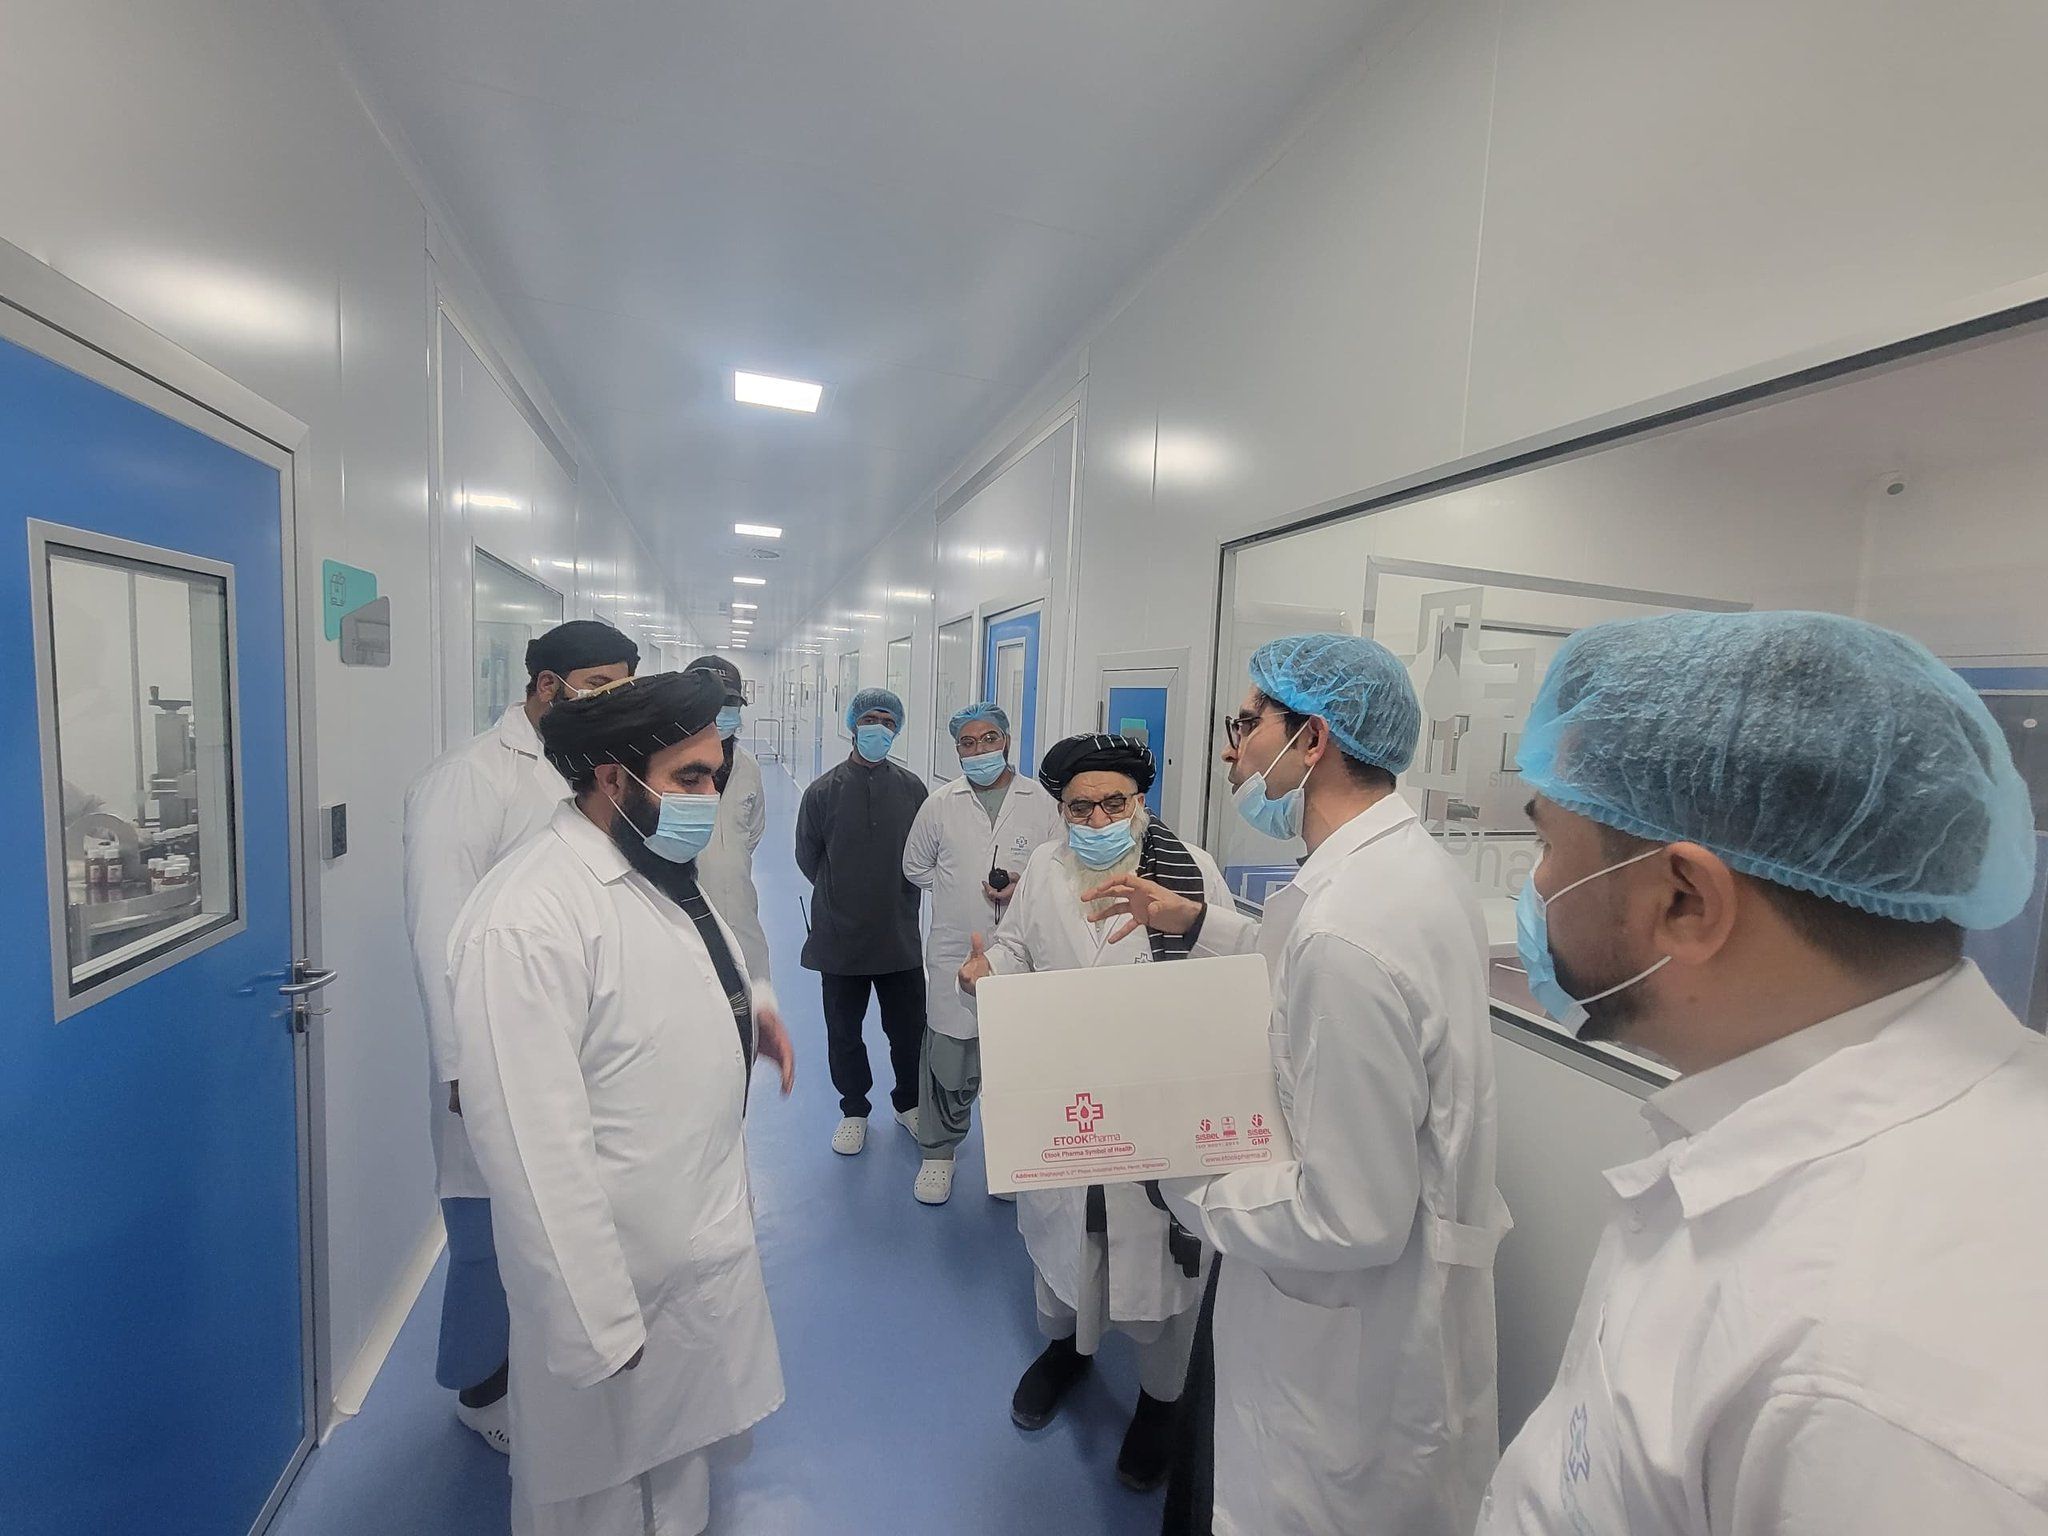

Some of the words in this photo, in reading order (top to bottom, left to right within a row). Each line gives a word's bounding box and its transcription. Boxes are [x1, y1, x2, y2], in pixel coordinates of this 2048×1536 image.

[1053, 1133, 1121, 1146] ETOOKPharma
[1251, 1138, 1270, 1146] GMP
[1062, 1149, 1084, 1157] Pharma
[1084, 1147, 1107, 1156] Symbol
[1114, 1145, 1133, 1153] Health
